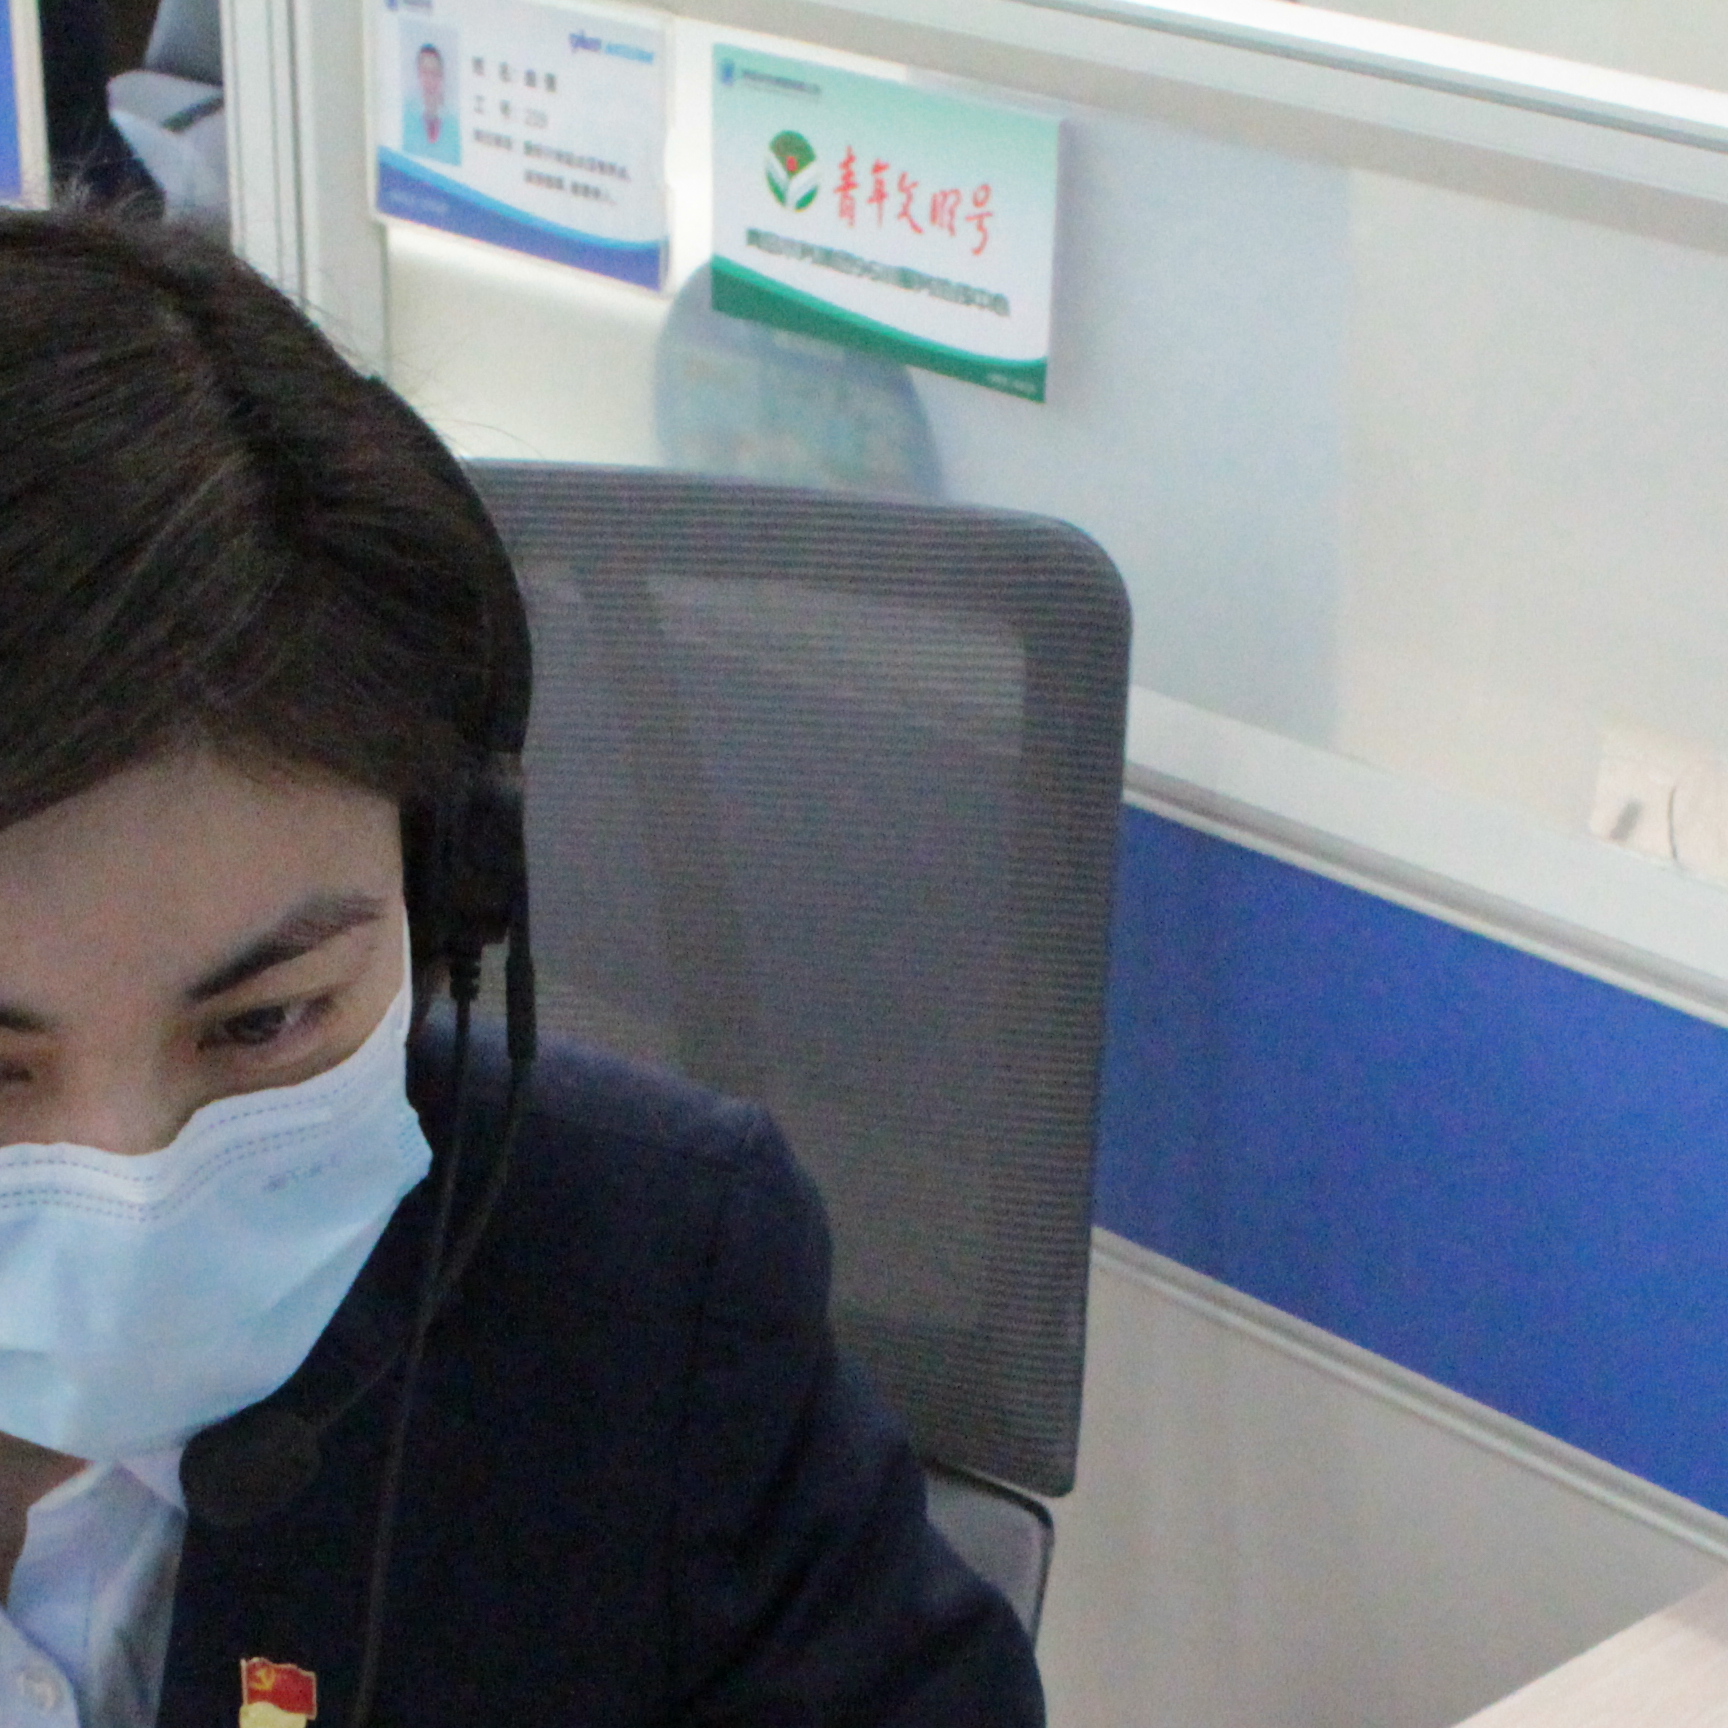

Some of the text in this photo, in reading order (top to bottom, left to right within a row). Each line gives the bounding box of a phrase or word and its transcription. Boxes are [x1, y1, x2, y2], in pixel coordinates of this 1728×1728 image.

[833, 144, 994, 256] 青年文明号
